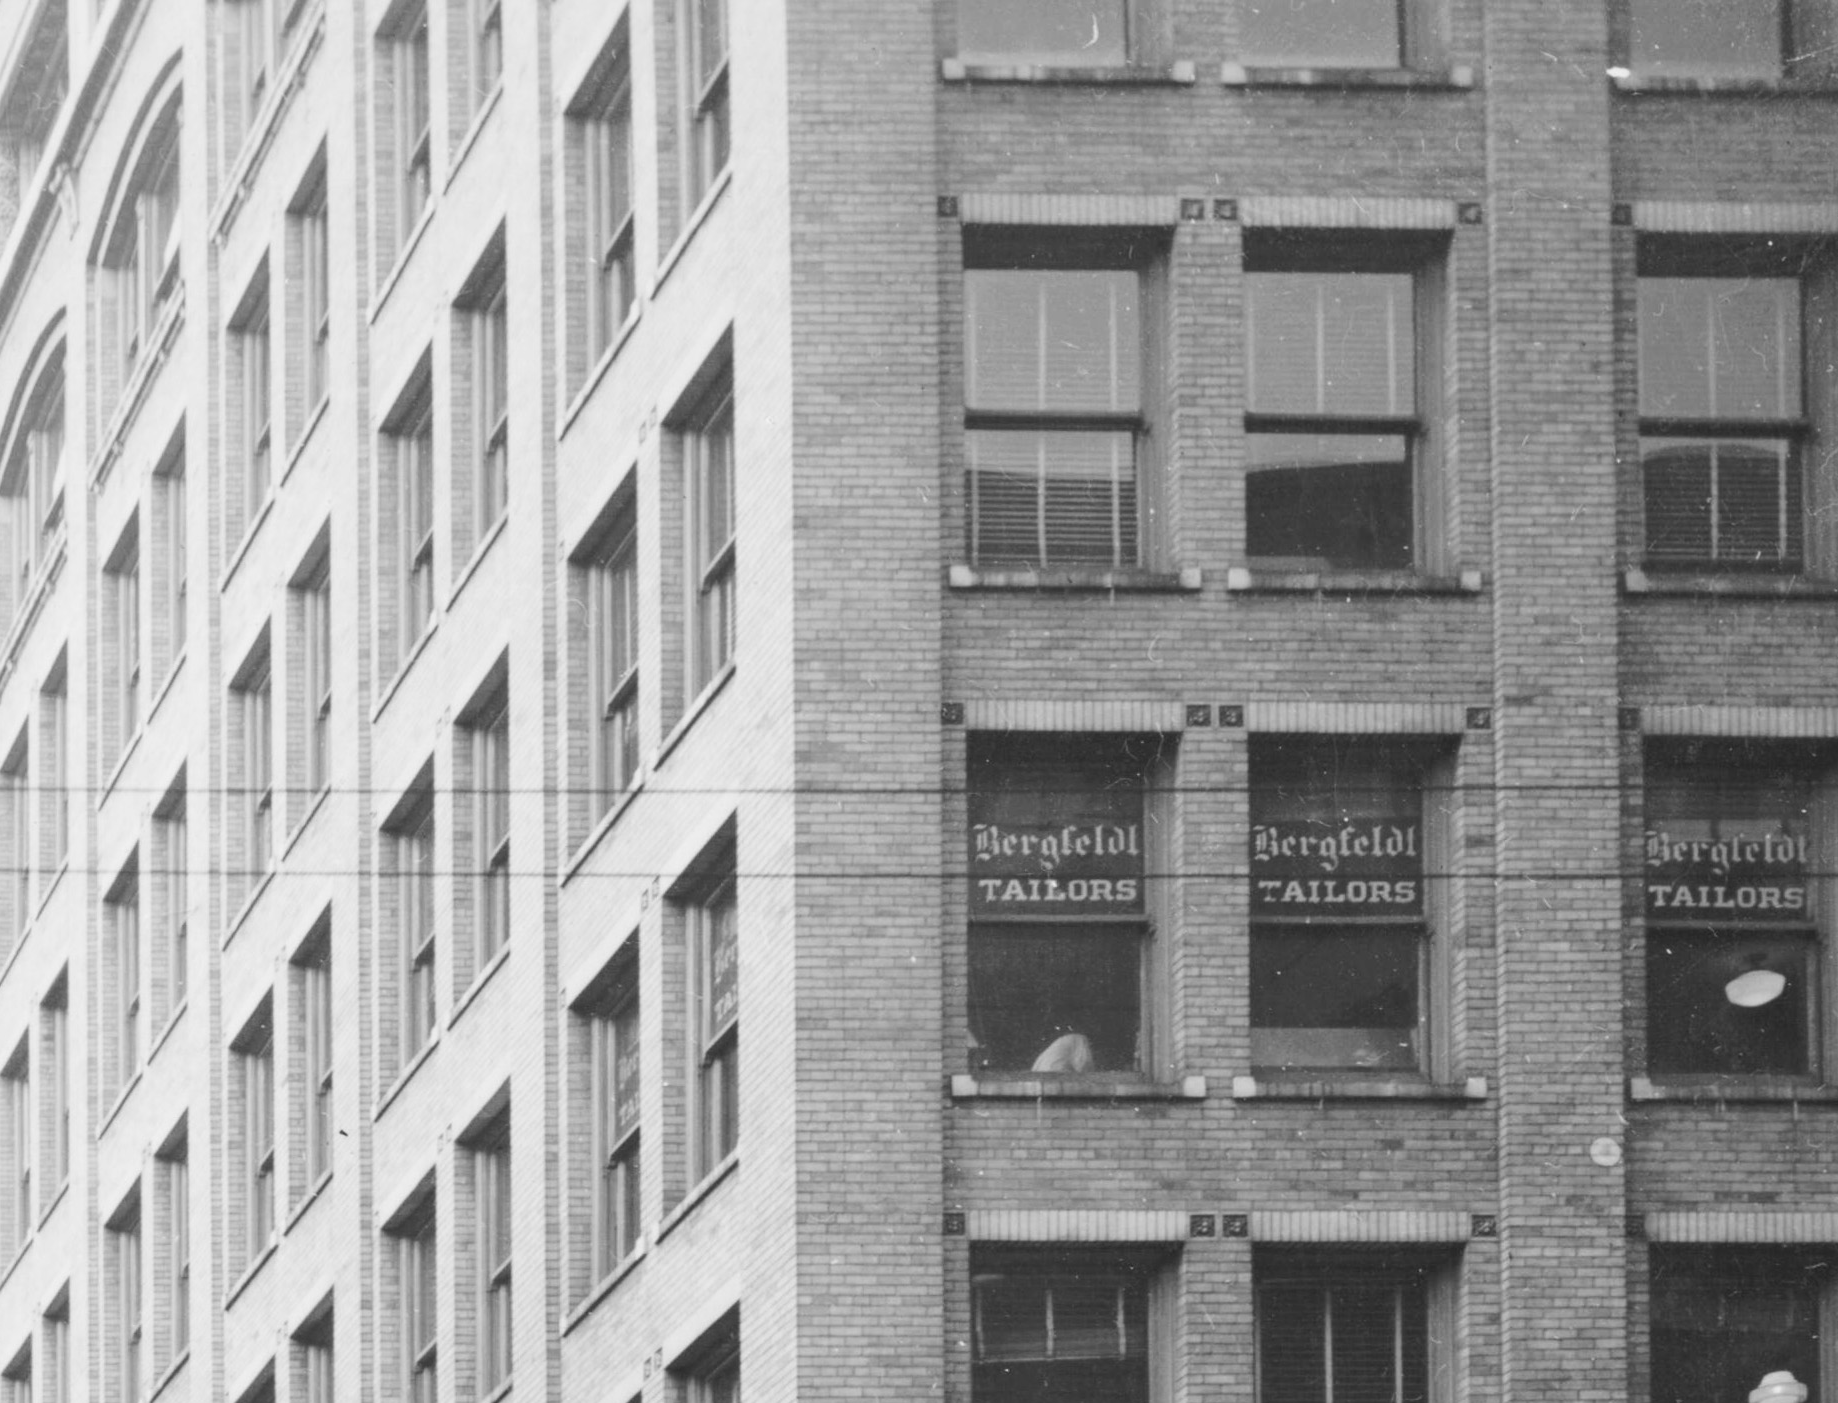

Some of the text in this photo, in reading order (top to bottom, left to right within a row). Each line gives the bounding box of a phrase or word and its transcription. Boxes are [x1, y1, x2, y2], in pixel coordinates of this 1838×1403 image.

[978, 878, 1137, 903] TAILORS
[1257, 880, 1417, 904] TAILORS
[1648, 884, 1806, 910] TAILORS
